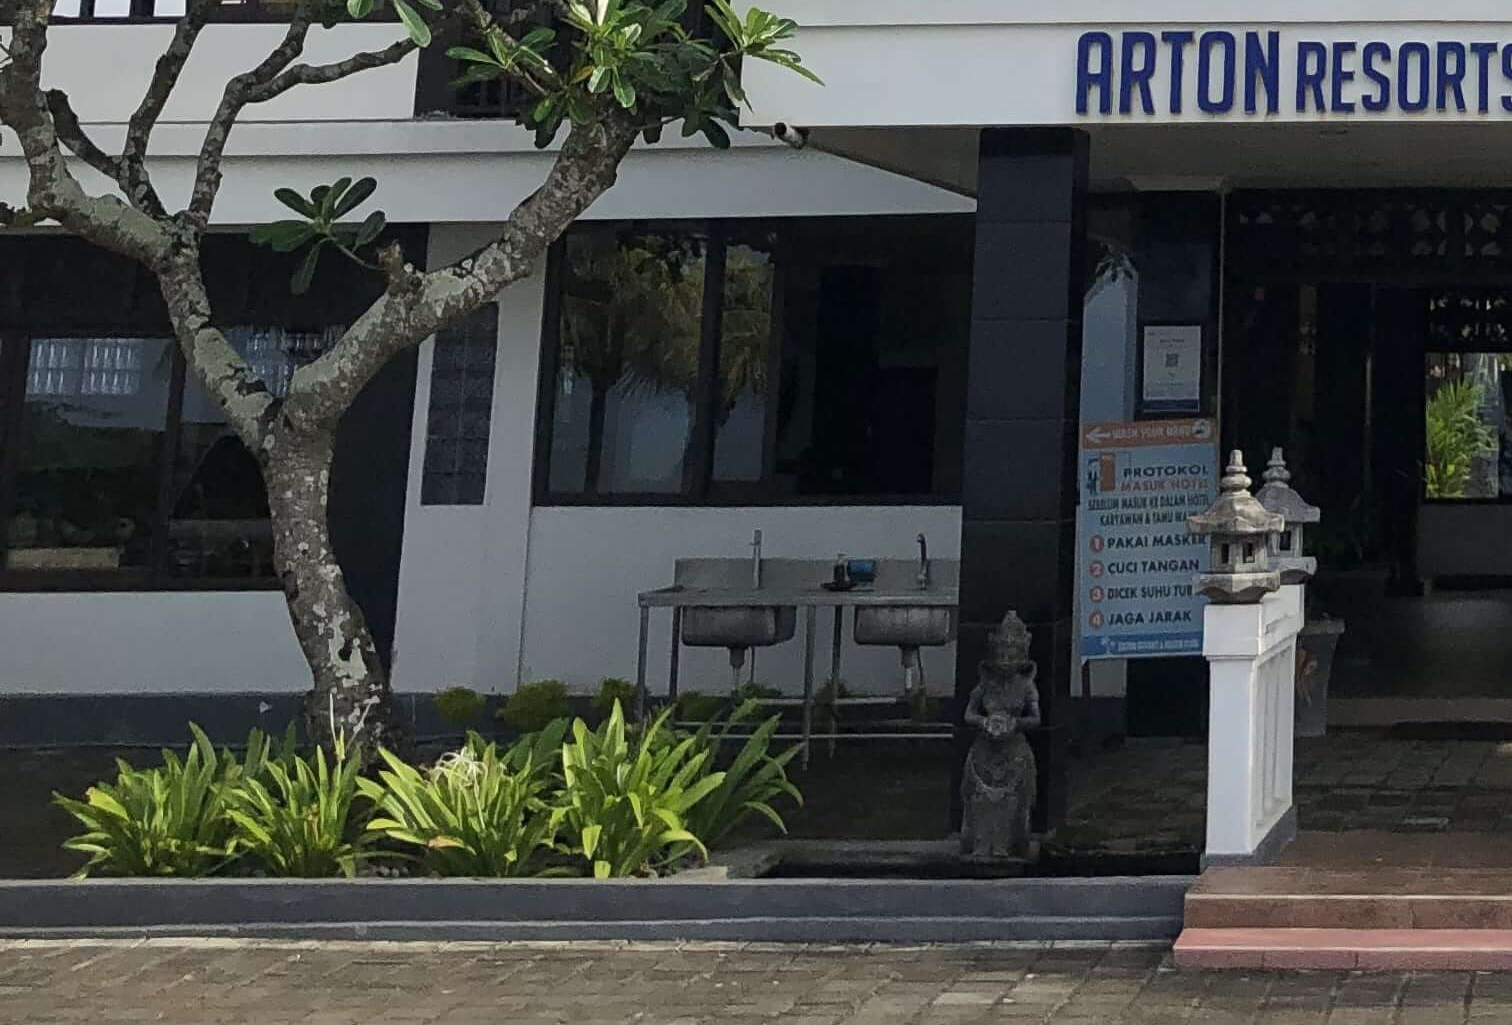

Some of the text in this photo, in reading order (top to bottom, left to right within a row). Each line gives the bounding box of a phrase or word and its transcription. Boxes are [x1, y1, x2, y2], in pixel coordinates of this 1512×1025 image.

[1075, 31, 1279, 115] ARTON
[1123, 464, 1209, 479] PROTOKOL
[1120, 478, 1209, 492] MASUK HOTEL
[1121, 497, 1147, 509] MASUK
[1160, 494, 1186, 507] DALAM
[1107, 535, 1148, 549] PAKAI
[1152, 533, 1207, 547] MASKER
[1107, 561, 1138, 574] CUCI
[1141, 559, 1200, 573] TANGAN
[1107, 586, 1138, 600] DICEK
[1141, 585, 1171, 598] SUHU
[1107, 612, 1145, 625] JAGA
[1149, 610, 1192, 623] JARAK
